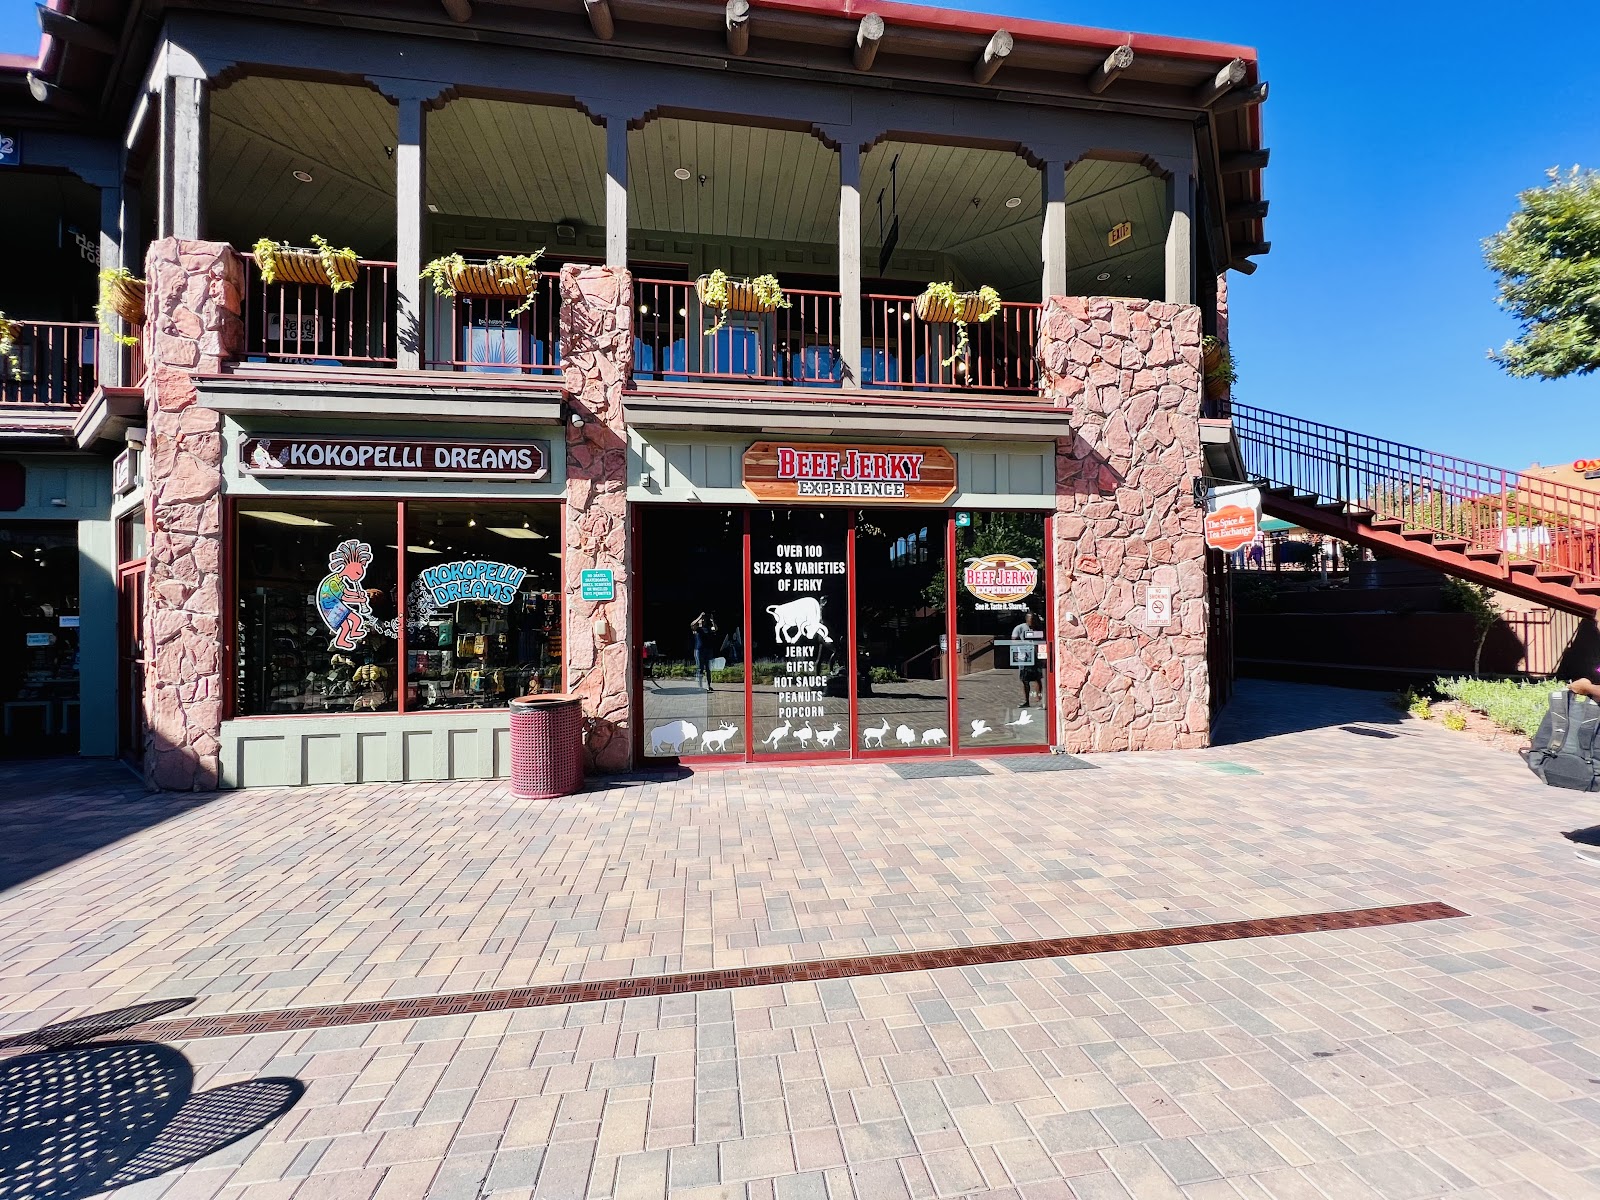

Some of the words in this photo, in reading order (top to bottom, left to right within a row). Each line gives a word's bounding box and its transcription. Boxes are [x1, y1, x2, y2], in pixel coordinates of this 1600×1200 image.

[290, 444, 422, 468] KOKOPELLI
[434, 447, 533, 470] DREAMS
[777, 447, 840, 479] BEEF
[841, 449, 924, 481] JERKY
[797, 480, 905, 497] EXPERIENCE
[1208, 520, 1220, 528] The
[1220, 517, 1238, 529] Spice
[1238, 515, 1246, 524] &
[1208, 530, 1220, 539] Tea
[1220, 526, 1252, 537] Exchange
[776, 544, 803, 558] OVER
[804, 544, 823, 558] 100
[422, 560, 526, 589] KOKOPELLI
[753, 561, 783, 575] SIZES
[784, 561, 793, 575] &
[795, 561, 846, 575] VARIETIES
[965, 568, 996, 585] BEEF
[996, 568, 1036, 586] JERKY
[432, 580, 515, 604] DREAMS
[777, 579, 791, 592] OF
[792, 579, 823, 592] JERKY
[975, 585, 1027, 594] EXPERIENCE
[784, 645, 815, 658] JERKY
[786, 660, 815, 673] GIFTS
[773, 676, 793, 688] HOT
[795, 675, 828, 688] SAUCE
[778, 690, 823, 703] PEANUTS
[778, 705, 825, 719] POPCORN
